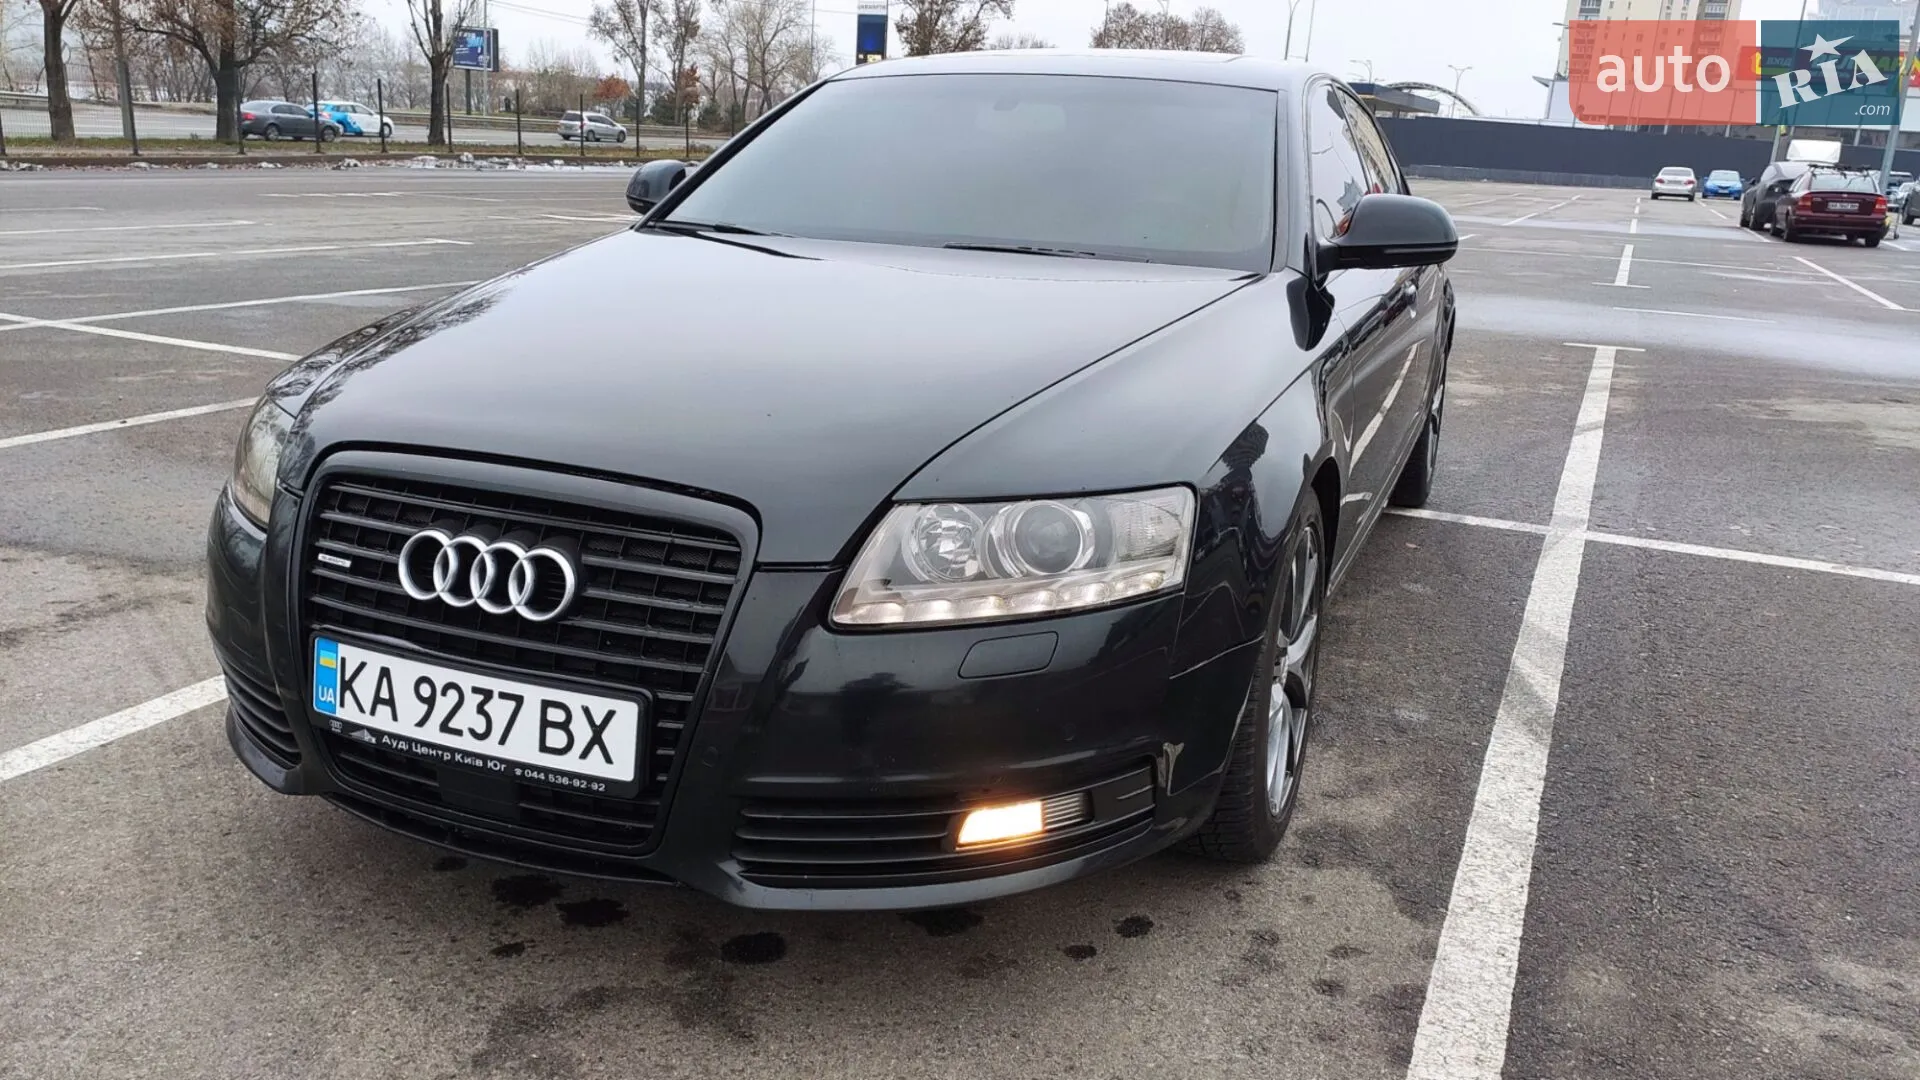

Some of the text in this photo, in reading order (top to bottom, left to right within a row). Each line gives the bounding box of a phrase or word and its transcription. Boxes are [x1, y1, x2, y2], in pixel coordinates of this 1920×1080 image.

[319, 685, 336, 705] UA
[339, 656, 617, 765] KA 9237 BX
[381, 735, 506, 772] Ауді Центр Київ Юг
[524, 770, 546, 780] 044
